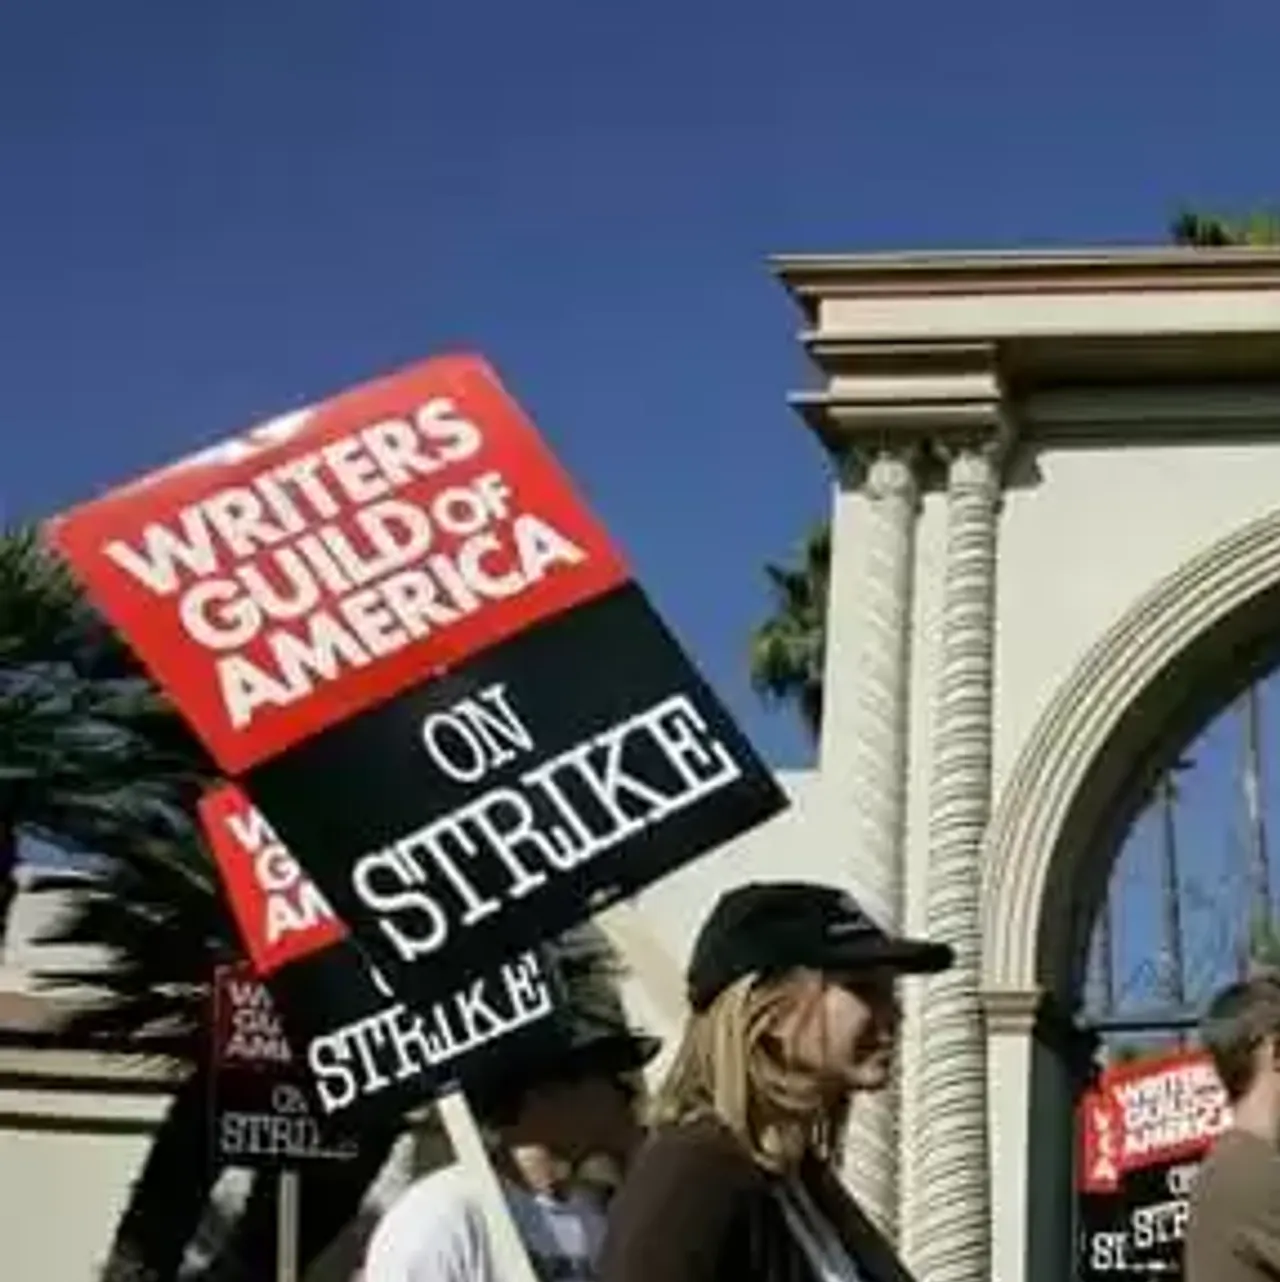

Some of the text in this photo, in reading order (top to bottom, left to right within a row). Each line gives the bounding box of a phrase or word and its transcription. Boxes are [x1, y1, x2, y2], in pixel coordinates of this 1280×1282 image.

[103, 397, 482, 594] WRITERS
[178, 472, 511, 652] GUILD OF
[211, 514, 586, 729] AMERICA
[423, 683, 536, 784] ON
[352, 694, 742, 962] STRIKE
[307, 951, 553, 1116] STRIKE
[219, 1110, 358, 1160] STRI
[1132, 1199, 1189, 1249] STR
